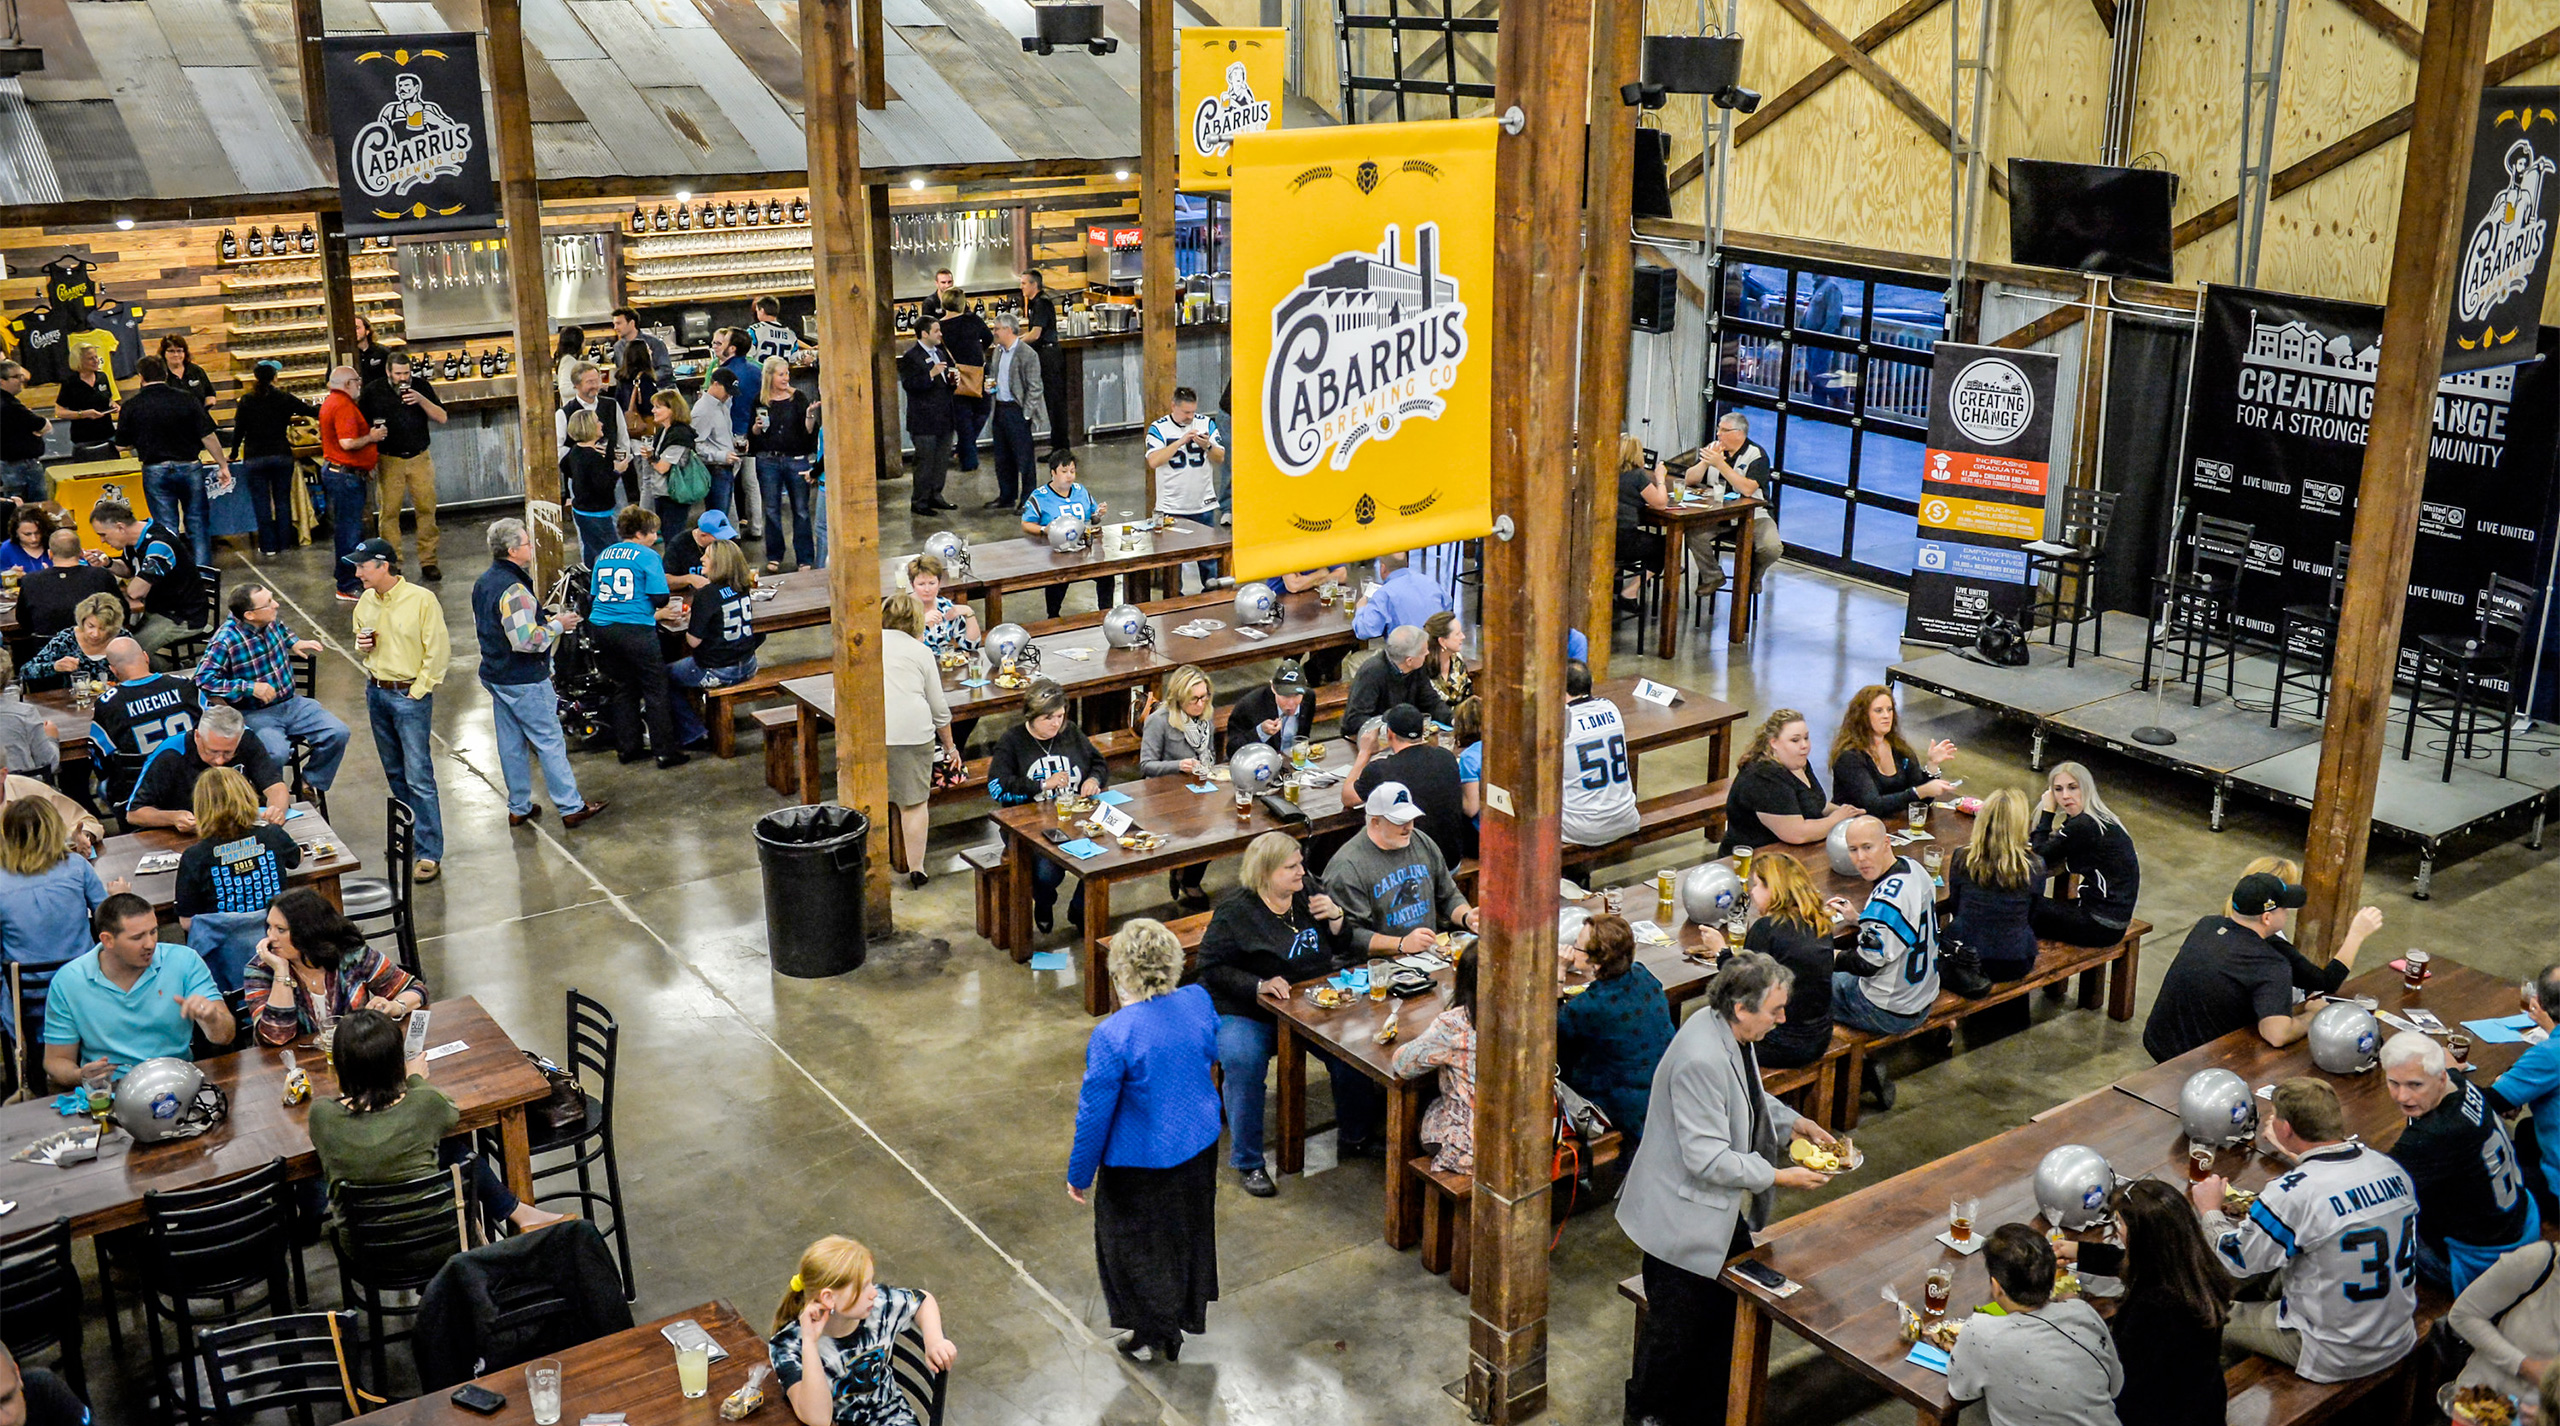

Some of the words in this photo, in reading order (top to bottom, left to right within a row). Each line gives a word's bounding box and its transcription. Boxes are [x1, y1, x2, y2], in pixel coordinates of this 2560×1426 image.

[1195, 99, 1268, 153] CABARRUS
[356, 125, 469, 193] CABARRUS
[389, 157, 443, 183] BREWING
[450, 151, 465, 162] CO
[2462, 221, 2543, 316] CABARRUS
[769, 329, 788, 340] DAVIS
[1270, 311, 1461, 467] CABARRUS
[2238, 368, 2375, 420] CREATING
[1324, 377, 1415, 441] BREWING
[1429, 365, 1452, 388] CO
[1960, 391, 2024, 412] CREATING
[1961, 407, 2019, 428] CHANGE
[2236, 403, 2269, 429] FOR
[2272, 410, 2284, 432] A
[2288, 412, 2370, 446] STRONGE
[2433, 396, 2510, 441] ANGE
[1166, 438, 1205, 469] 59
[2430, 436, 2504, 468] MUNITY
[1973, 464, 2030, 476] GRADUATION
[1976, 457, 2028, 469] INCREASING
[2198, 460, 2217, 470] United
[2204, 468, 2217, 478] Way
[1984, 473, 2011, 482] CHILDREN
[2023, 478, 2039, 486] YOUTH
[2242, 475, 2260, 488] LIVE
[2262, 478, 2292, 495] UNITED
[2304, 481, 2327, 492] United
[2312, 490, 2325, 500] Way
[1975, 504, 2020, 515] REDUCING
[2423, 504, 2447, 514] United
[2432, 512, 2446, 522] Way
[2477, 520, 2499, 534] LIVE
[2500, 524, 2535, 542] UNITED
[600, 547, 641, 561] KUECHLY
[1963, 547, 2022, 560] EMPOWERING
[2250, 542, 2267, 552] nited
[2254, 550, 2266, 560] Way
[1960, 554, 1999, 564] HEALTHY
[2292, 559, 2310, 573] LIVE
[597, 568, 635, 603] 59
[1955, 586, 1968, 595] LIVE
[1969, 588, 1989, 597] UNITED
[2408, 584, 2430, 598] LIVE
[2432, 588, 2465, 606] UNITED
[721, 596, 753, 642] 59
[2227, 612, 2245, 627] LVE
[2246, 616, 2276, 634] UNITED
[126, 688, 182, 718] KUECHLY
[1578, 711, 1616, 731] T.DAVIS
[1576, 733, 1628, 791] 58
[213, 835, 257, 858] CAROLINA
[221, 843, 266, 865] PANTHERS
[234, 859, 254, 871] 2015
[1373, 864, 1431, 899] CAROLINA
[2328, 1175, 2408, 1218] D.WILLIAMS
[2340, 1213, 2417, 1303] 34
